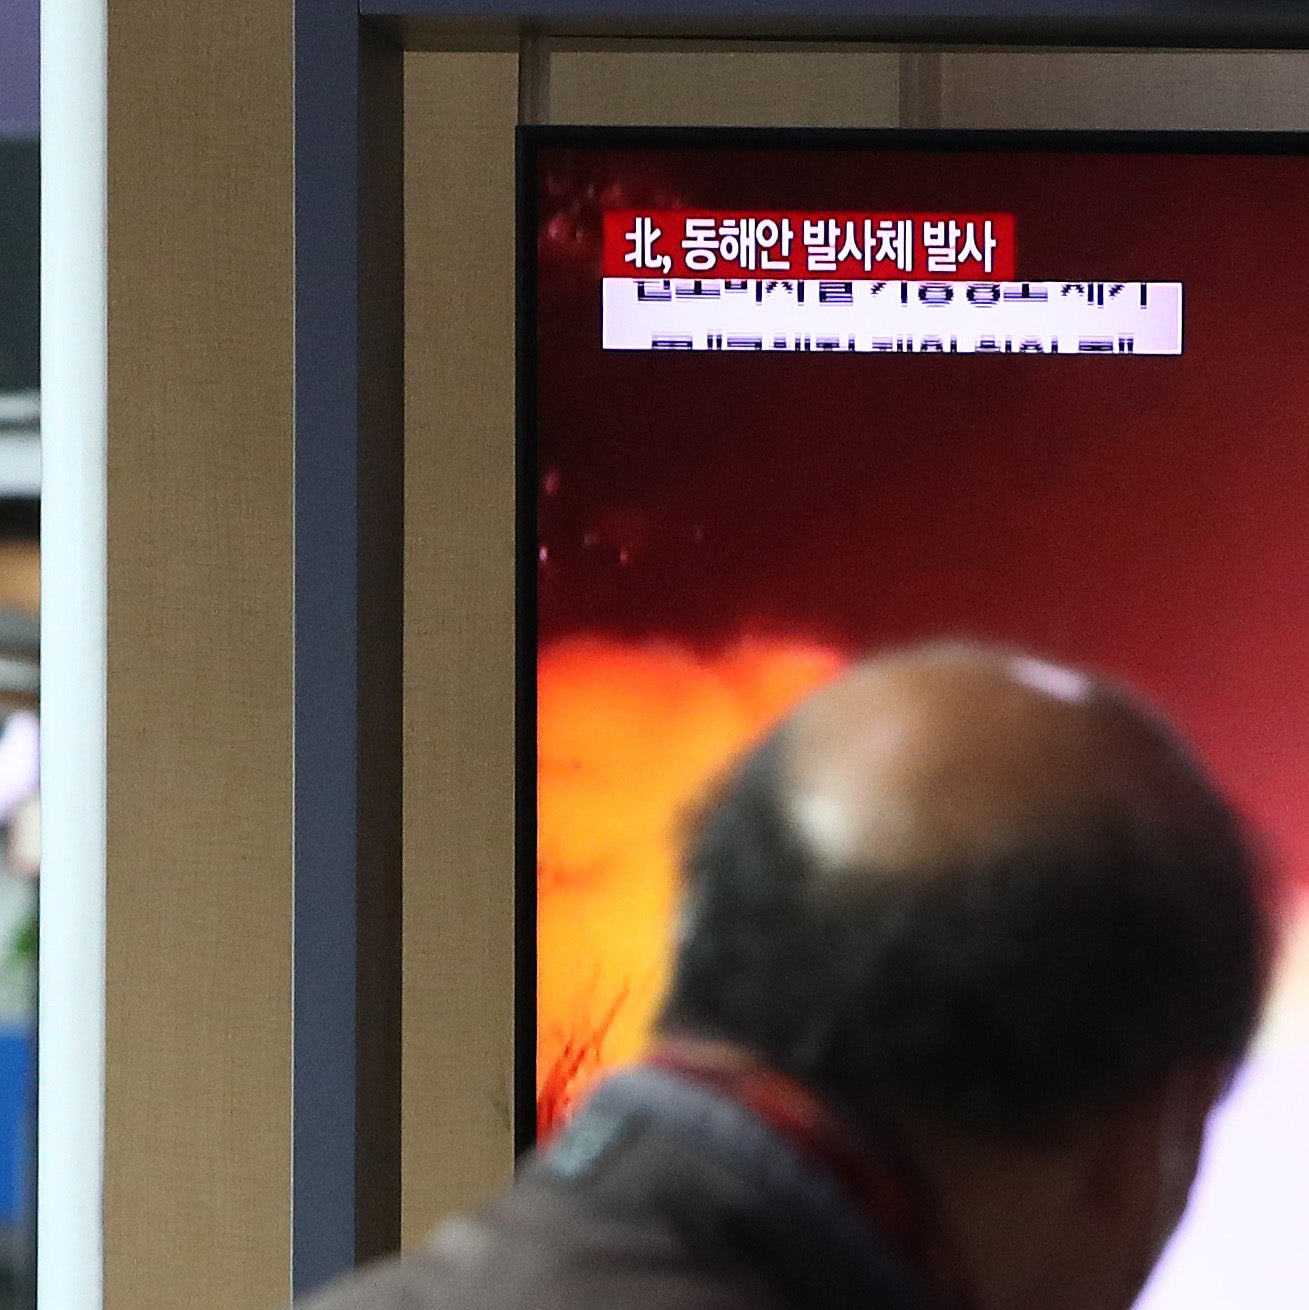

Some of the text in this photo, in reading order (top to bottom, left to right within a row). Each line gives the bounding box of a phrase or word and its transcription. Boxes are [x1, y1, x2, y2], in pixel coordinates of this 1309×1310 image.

[624, 217, 998, 274] 北, 동해안 발사체 발사
